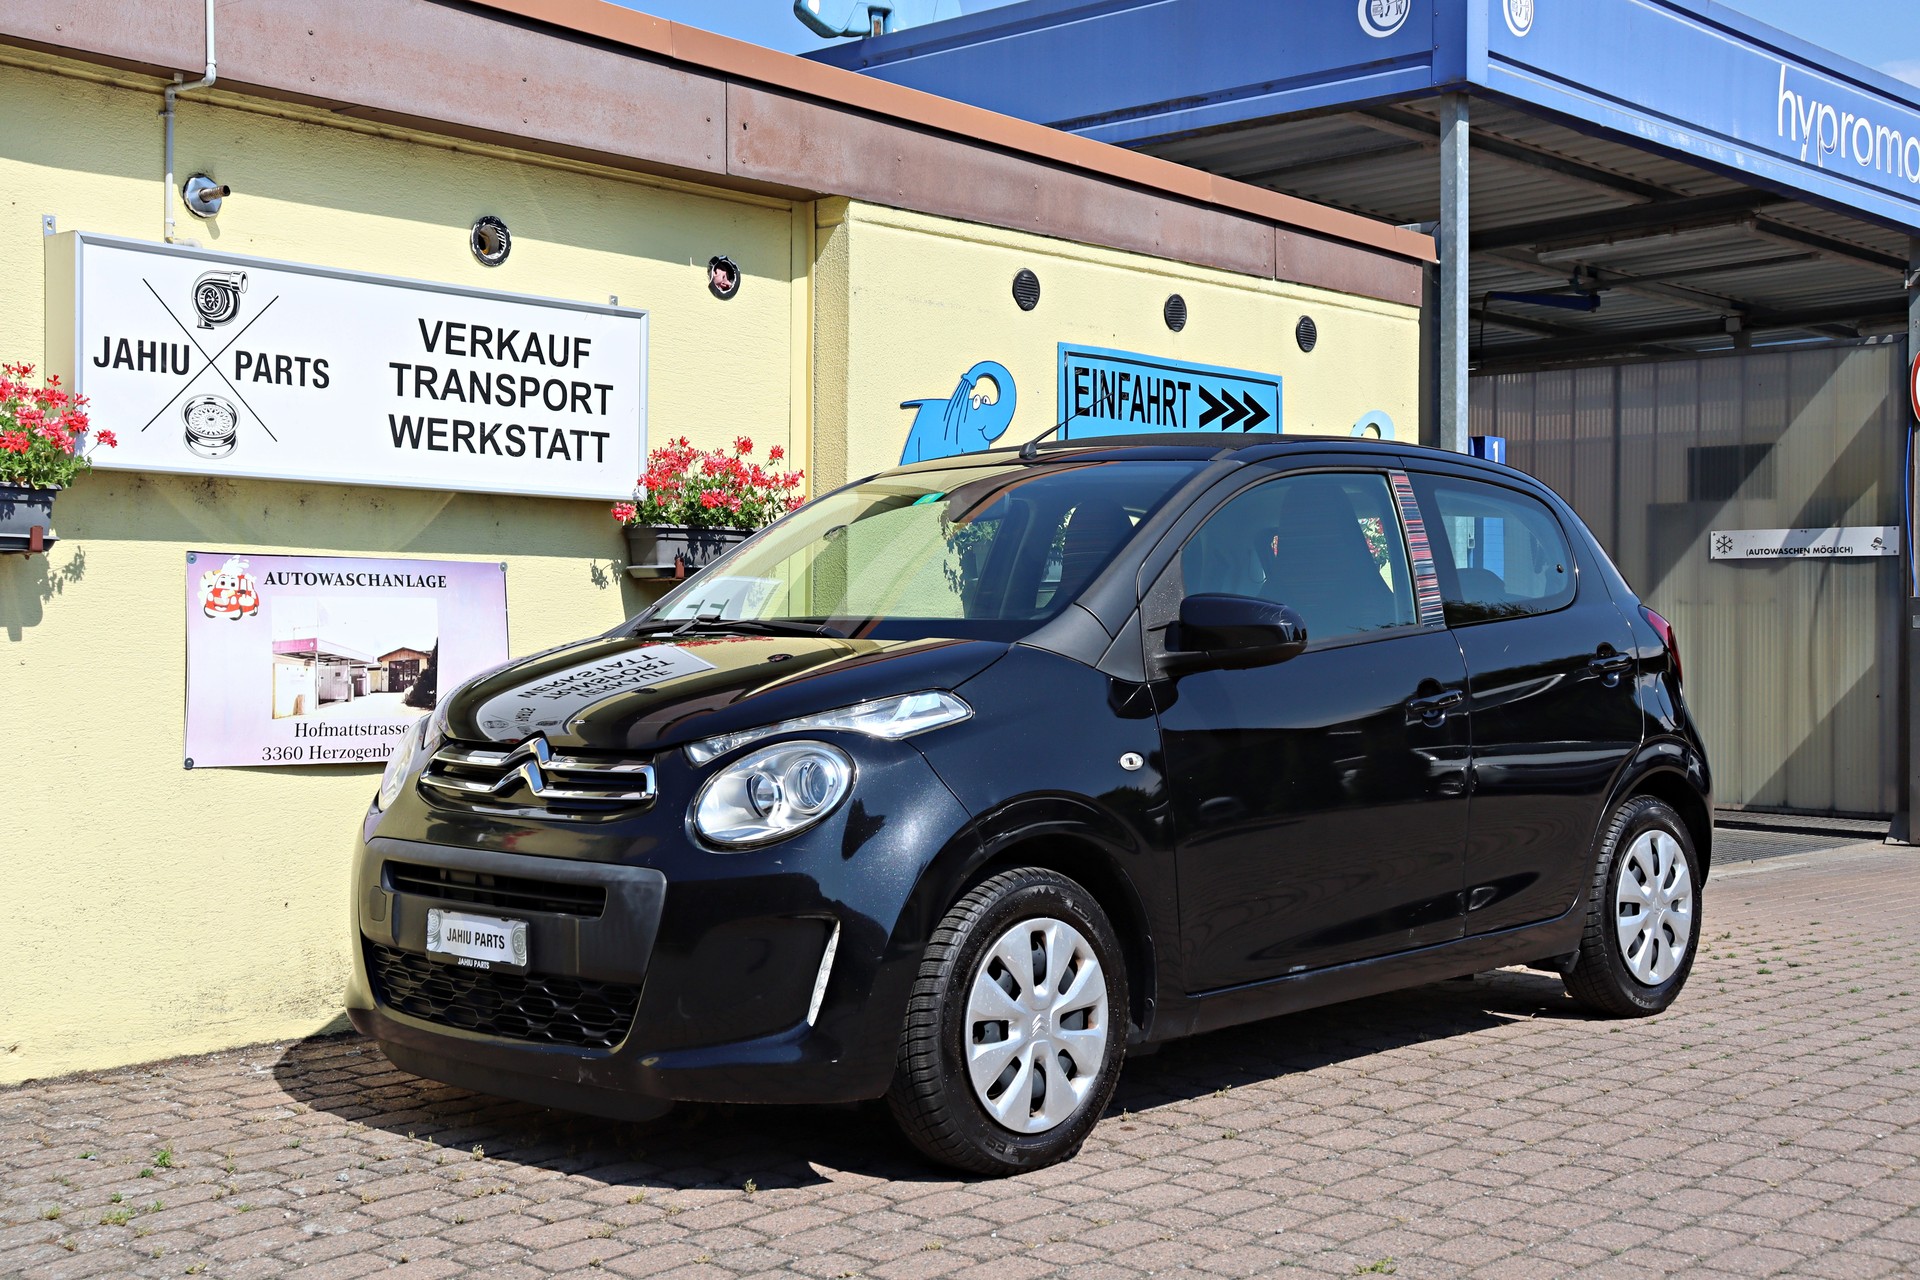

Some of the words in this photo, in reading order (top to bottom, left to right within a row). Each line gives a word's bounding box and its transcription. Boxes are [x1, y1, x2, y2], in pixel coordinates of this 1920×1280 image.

[418, 318, 592, 370] VERKAUF
[93, 335, 191, 376] JAHIU
[234, 350, 331, 390] PARTS
[389, 361, 614, 416] TRANSPORT
[1074, 366, 1192, 429] EINFAHRT
[389, 413, 611, 464] WERKSTATT
[1492, 440, 1499, 463] 1
[1745, 547, 1810, 557] (AUTOWASCHEN
[1812, 545, 1853, 556] MÖGLICH)
[263, 571, 448, 589] AUTOWASCHANLAGE
[294, 721, 410, 738] Hofmattstrasse
[262, 745, 303, 761] 3360
[309, 743, 395, 762] Herzogenb
[447, 928, 472, 944] JAHIU
[475, 932, 505, 949] PARTS
[474, 960, 490, 969] PARTS
